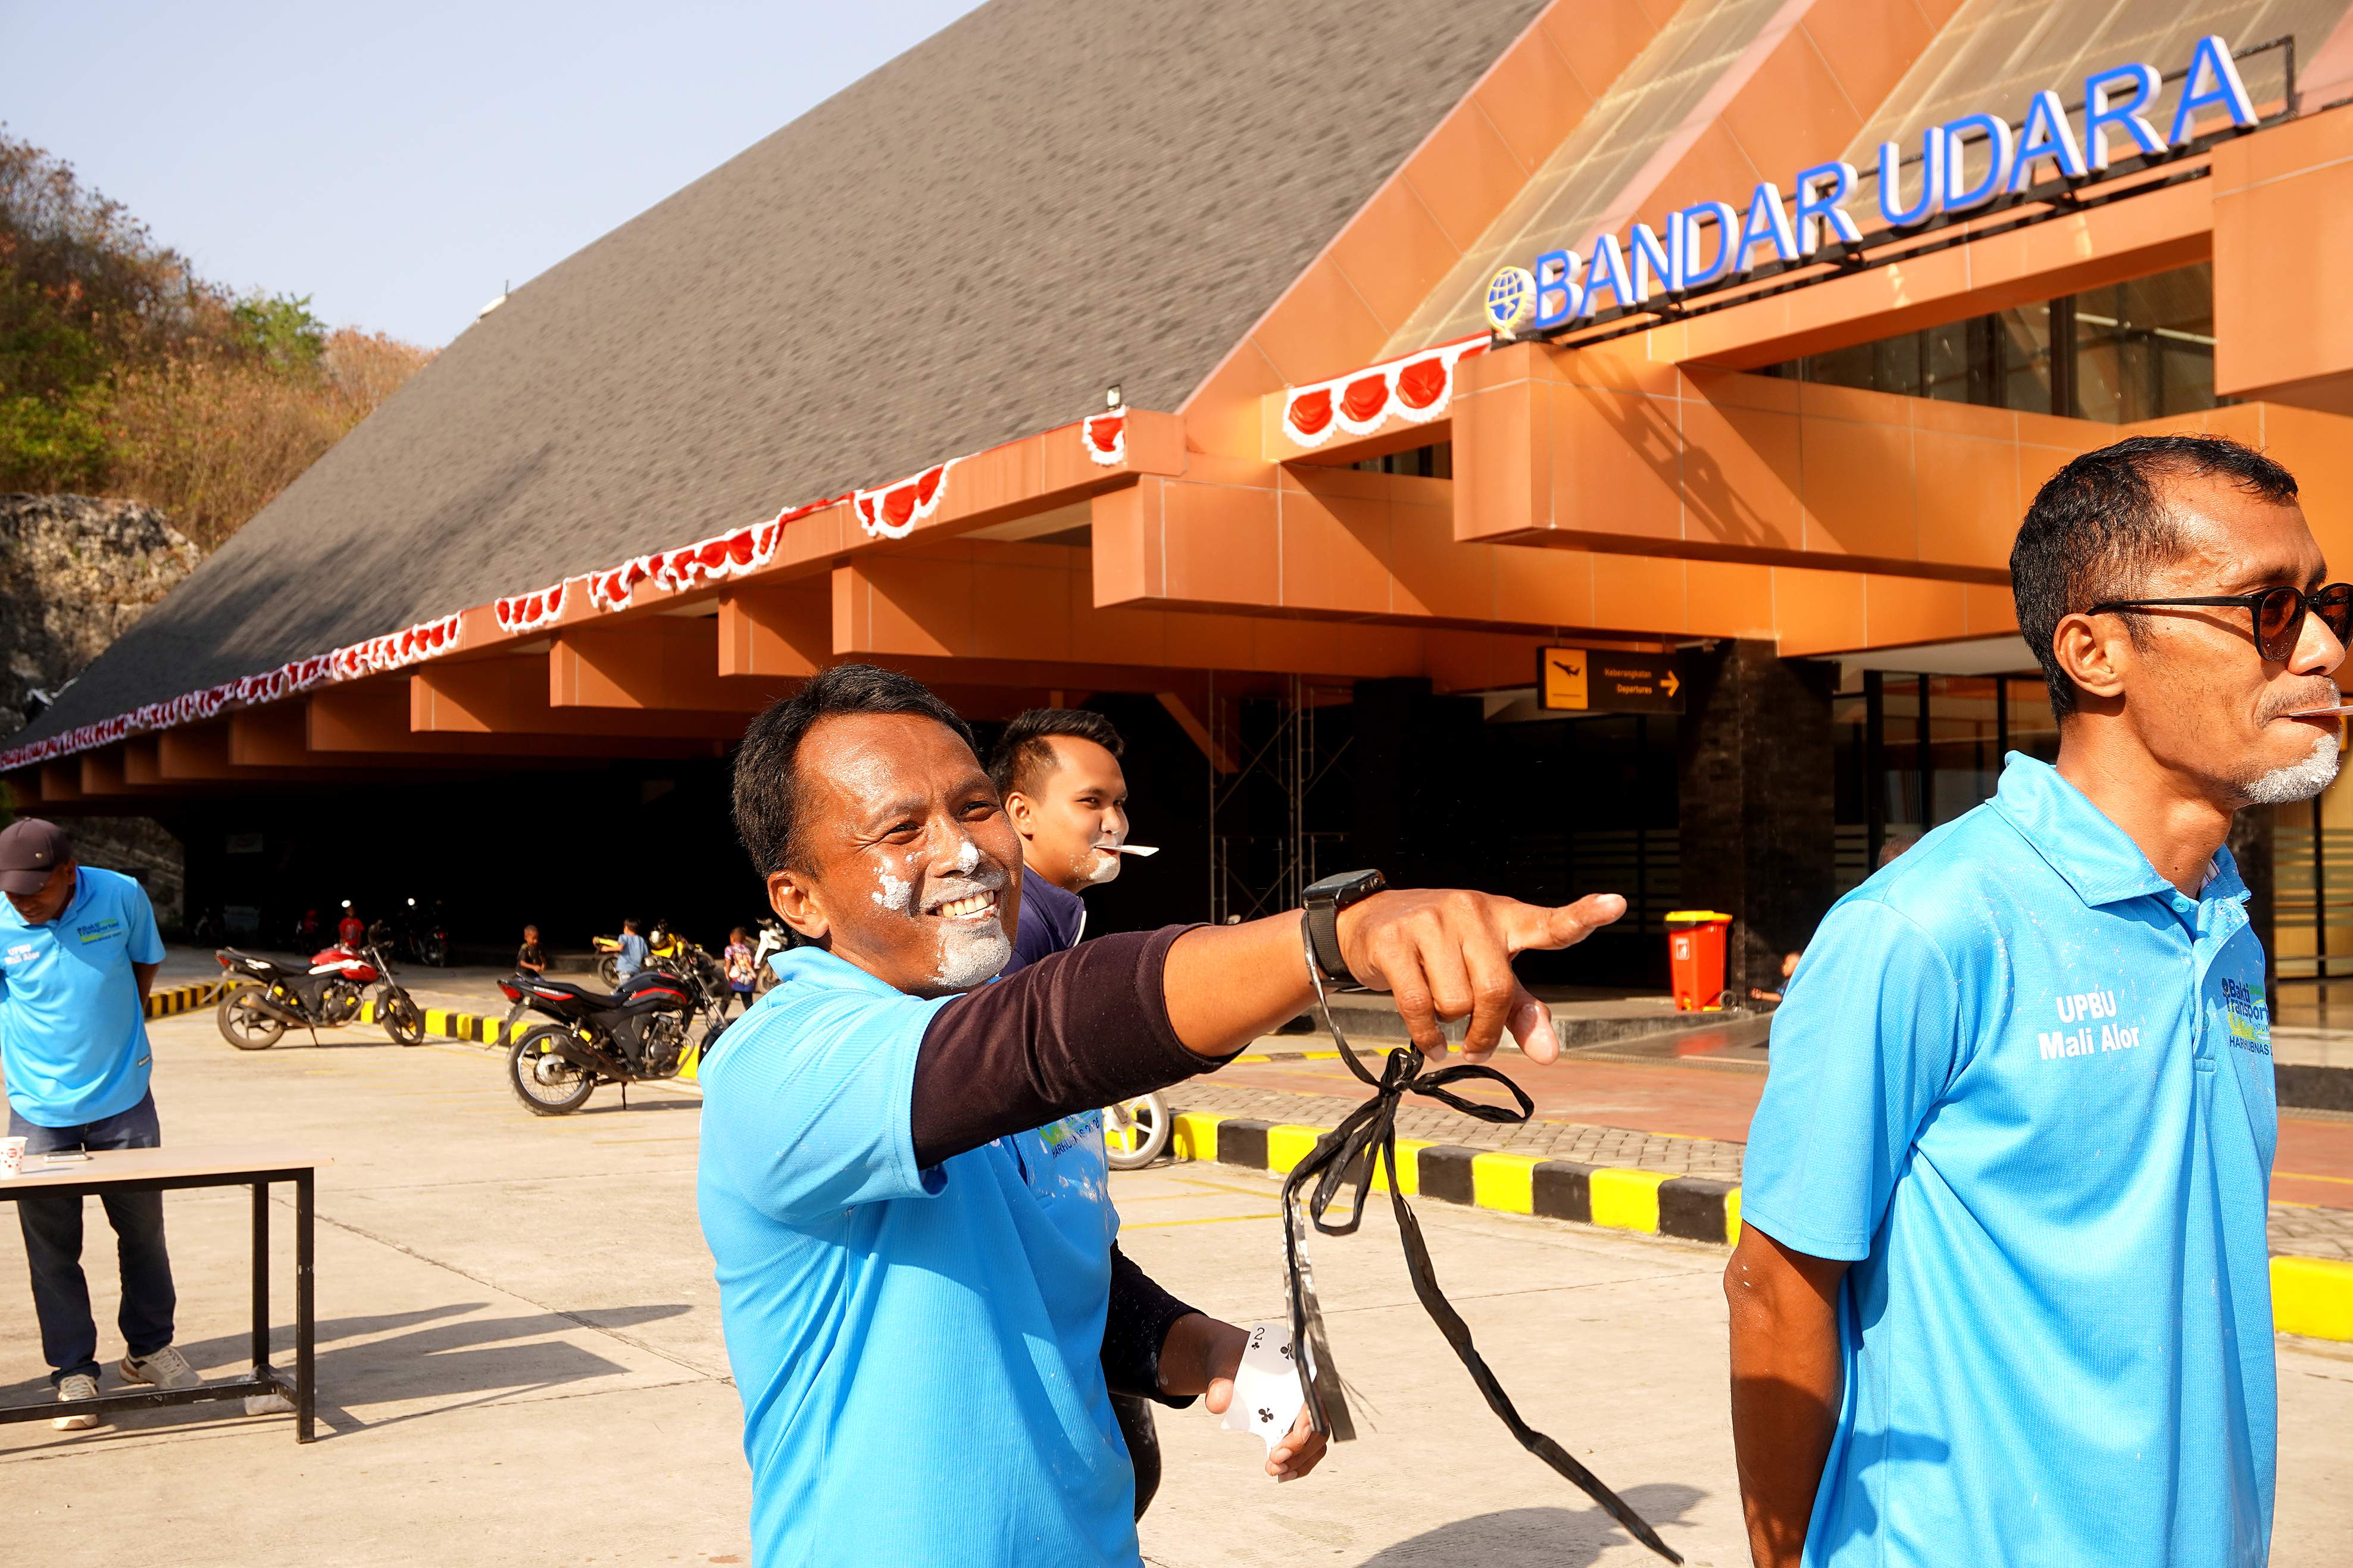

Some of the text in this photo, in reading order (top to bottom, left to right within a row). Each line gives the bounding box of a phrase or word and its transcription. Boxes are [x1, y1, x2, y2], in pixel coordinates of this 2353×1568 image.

[1535, 35, 2260, 329] BANDAR UDARA
[1604, 667, 1652, 680] Keberangkatan
[1617, 683, 1652, 695] Departures
[2228, 978, 2251, 1003] Bakti
[2056, 990, 2117, 1023] UPBU
[2038, 1022, 2140, 1060] Mali Alor
[2229, 1035, 2270, 1055] HARHUBNAS
[1254, 1327, 1265, 1340] 2
